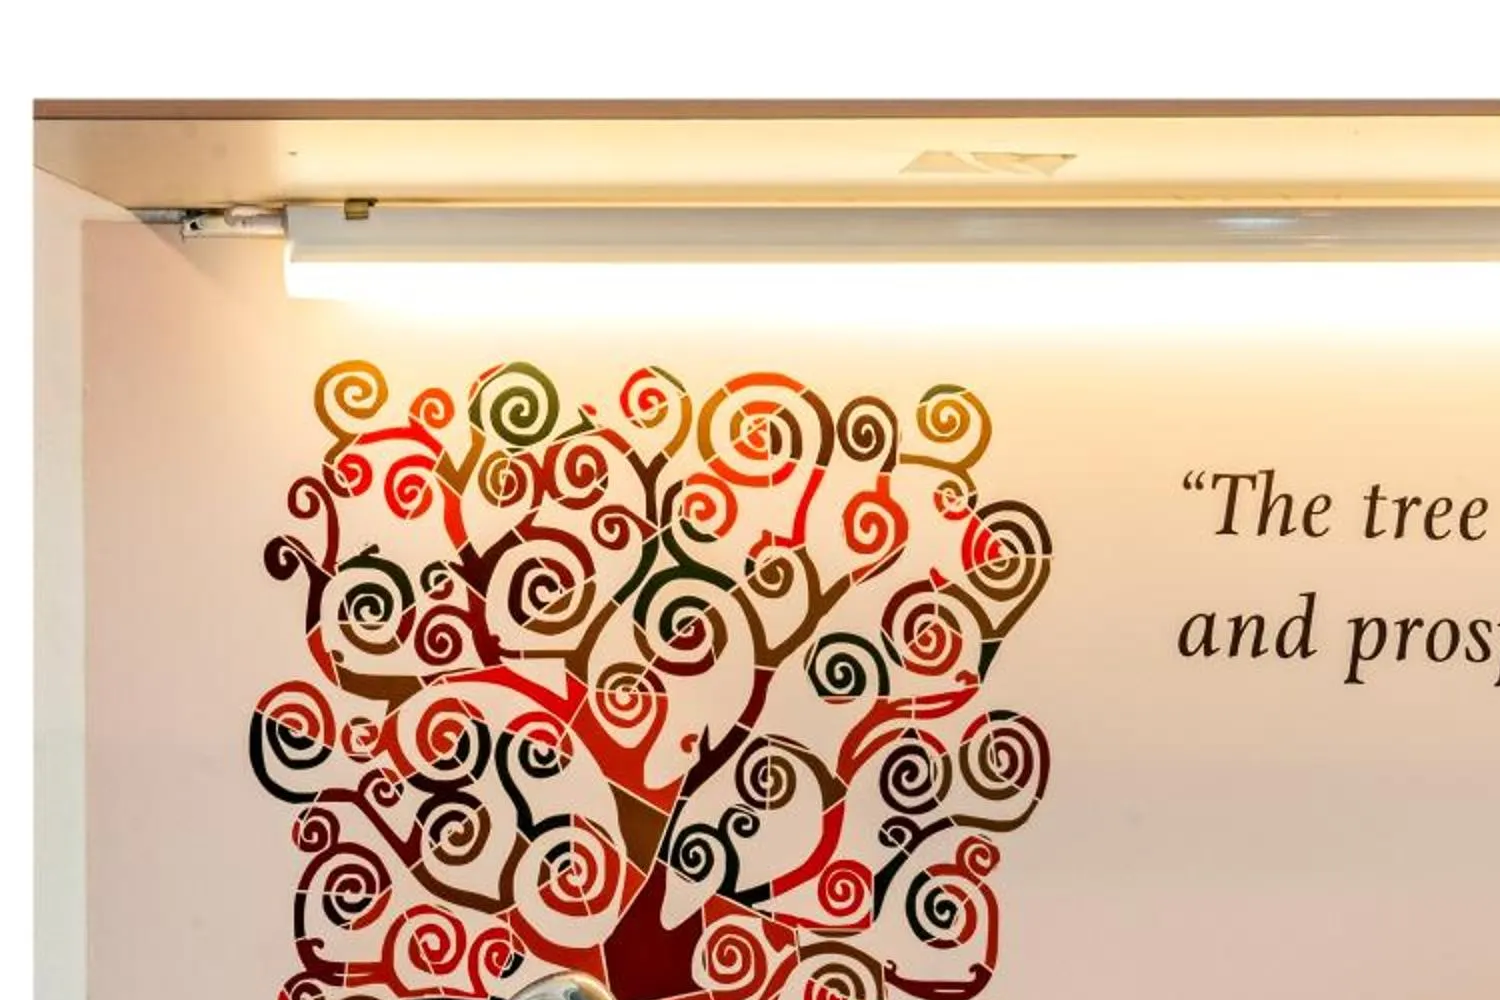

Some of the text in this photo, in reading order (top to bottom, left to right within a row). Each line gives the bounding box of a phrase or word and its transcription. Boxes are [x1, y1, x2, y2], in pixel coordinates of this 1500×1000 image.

[1182, 467, 1333, 539] “The
[1363, 483, 1489, 542] tree
[1177, 591, 1318, 660] and
